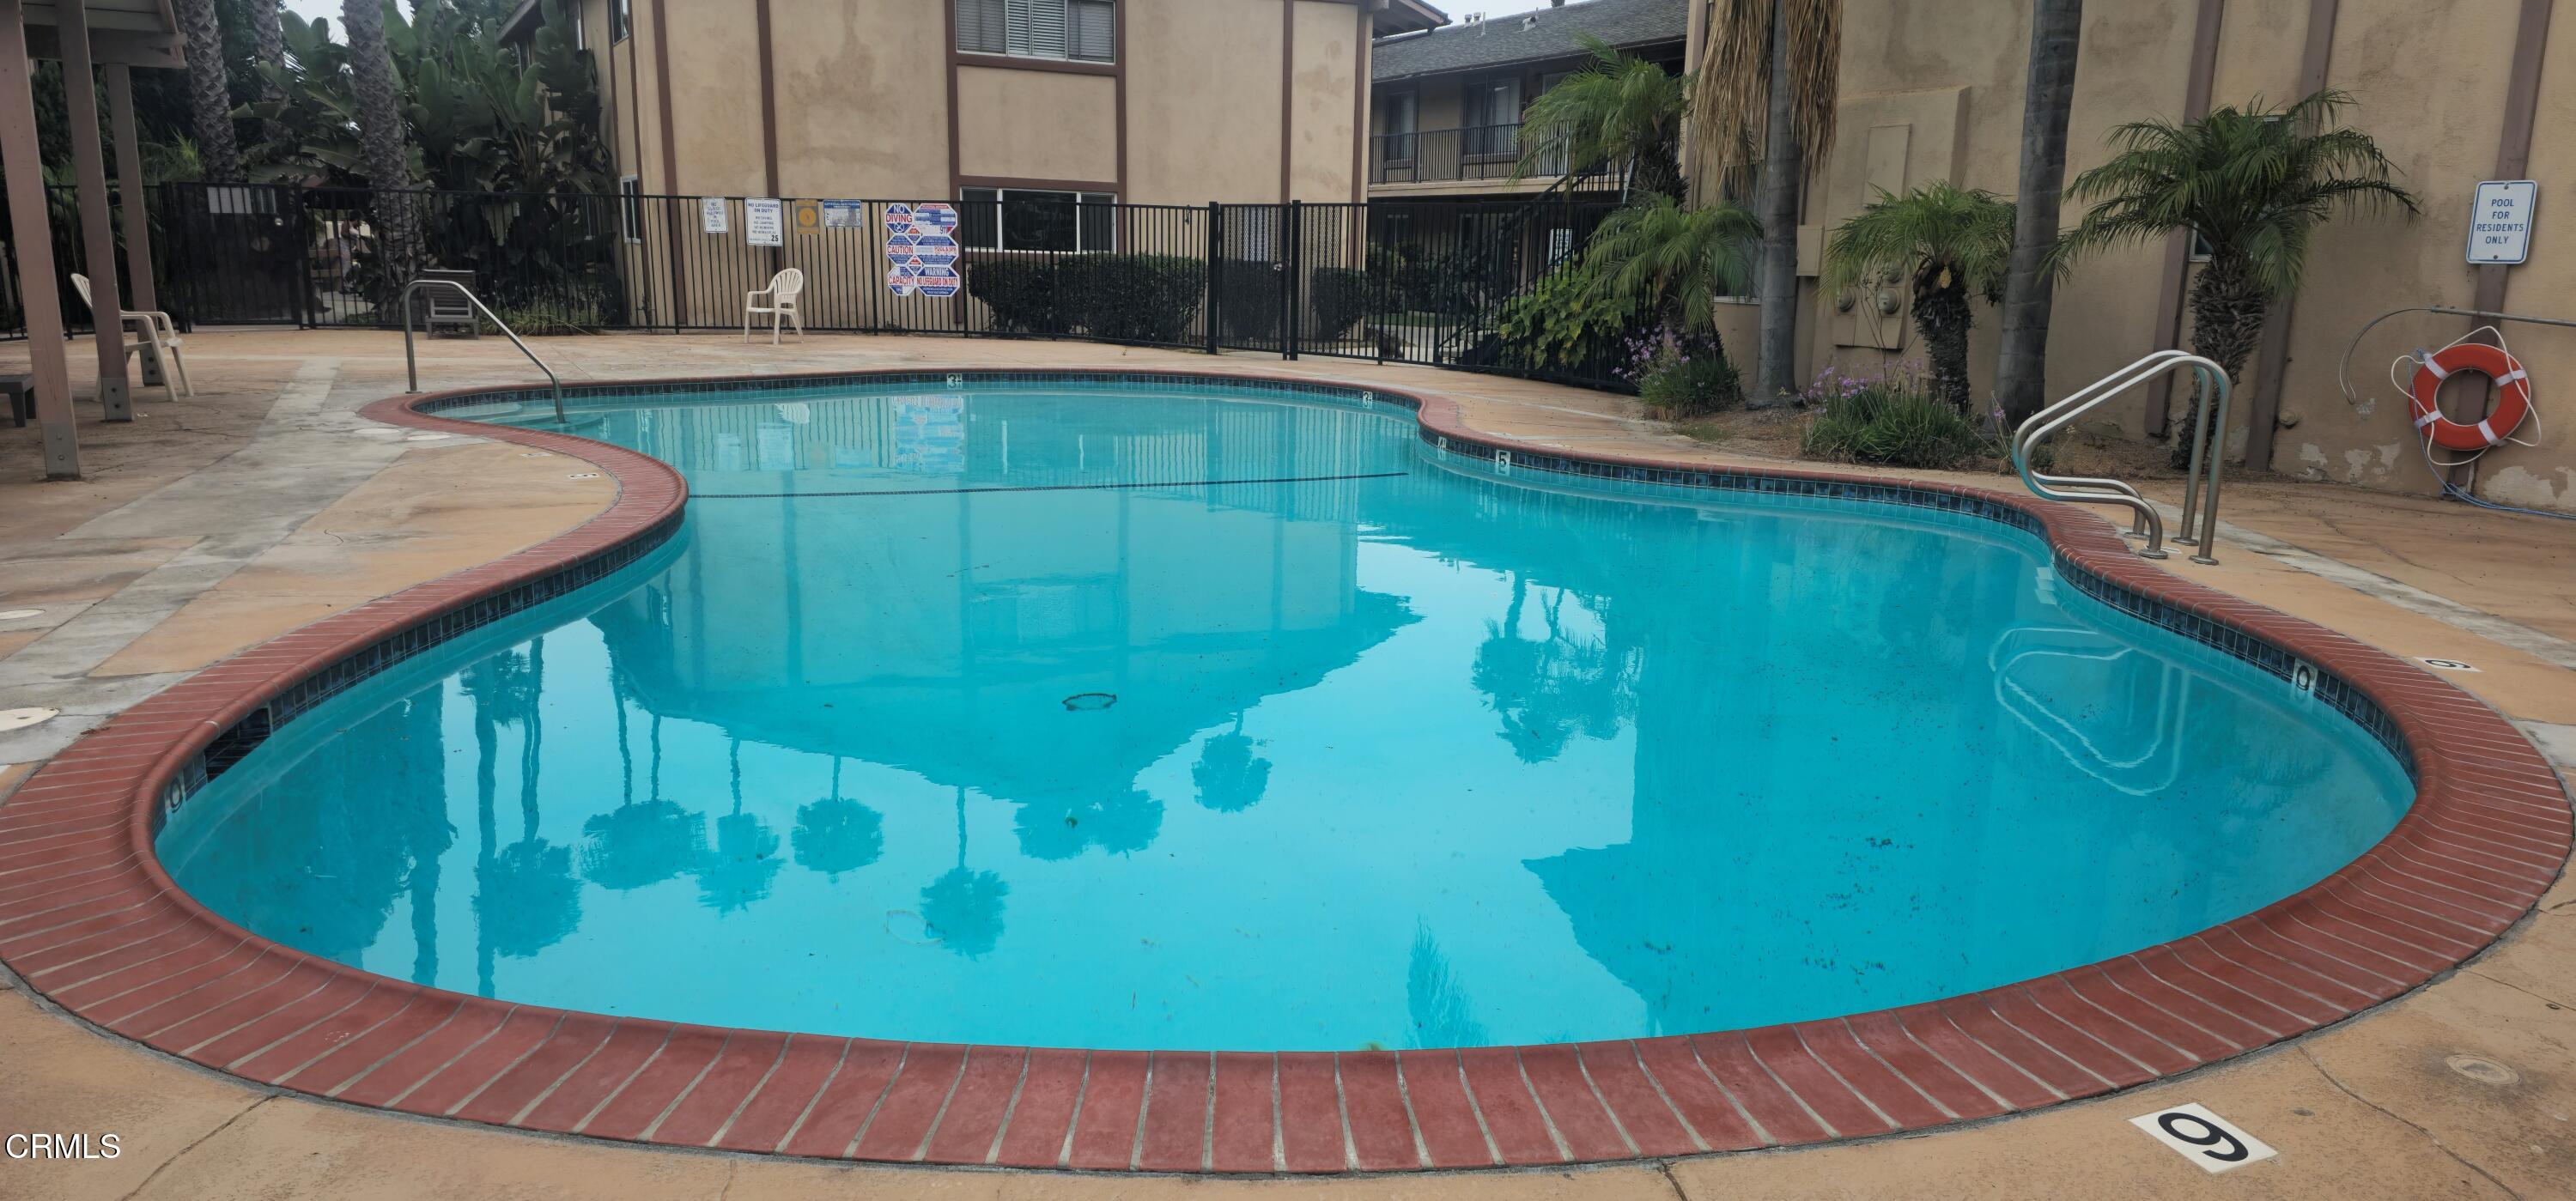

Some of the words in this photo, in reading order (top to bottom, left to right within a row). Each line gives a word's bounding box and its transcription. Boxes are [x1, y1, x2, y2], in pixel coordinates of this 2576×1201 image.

[2491, 198, 2514, 207] POOL
[894, 204, 904, 214] NO
[885, 213, 913, 222] DIVING
[2492, 211, 2510, 220] FOR
[2476, 223, 2524, 232] RESIDENTS
[887, 246, 914, 254] CAUTION
[924, 267, 950, 276] WARNING
[888, 276, 915, 286] CAPACITY
[916, 277, 922, 286] NO
[922, 276, 942, 286] LIFEGUARD
[942, 277, 948, 286] ON
[948, 276, 957, 286] DUTY
